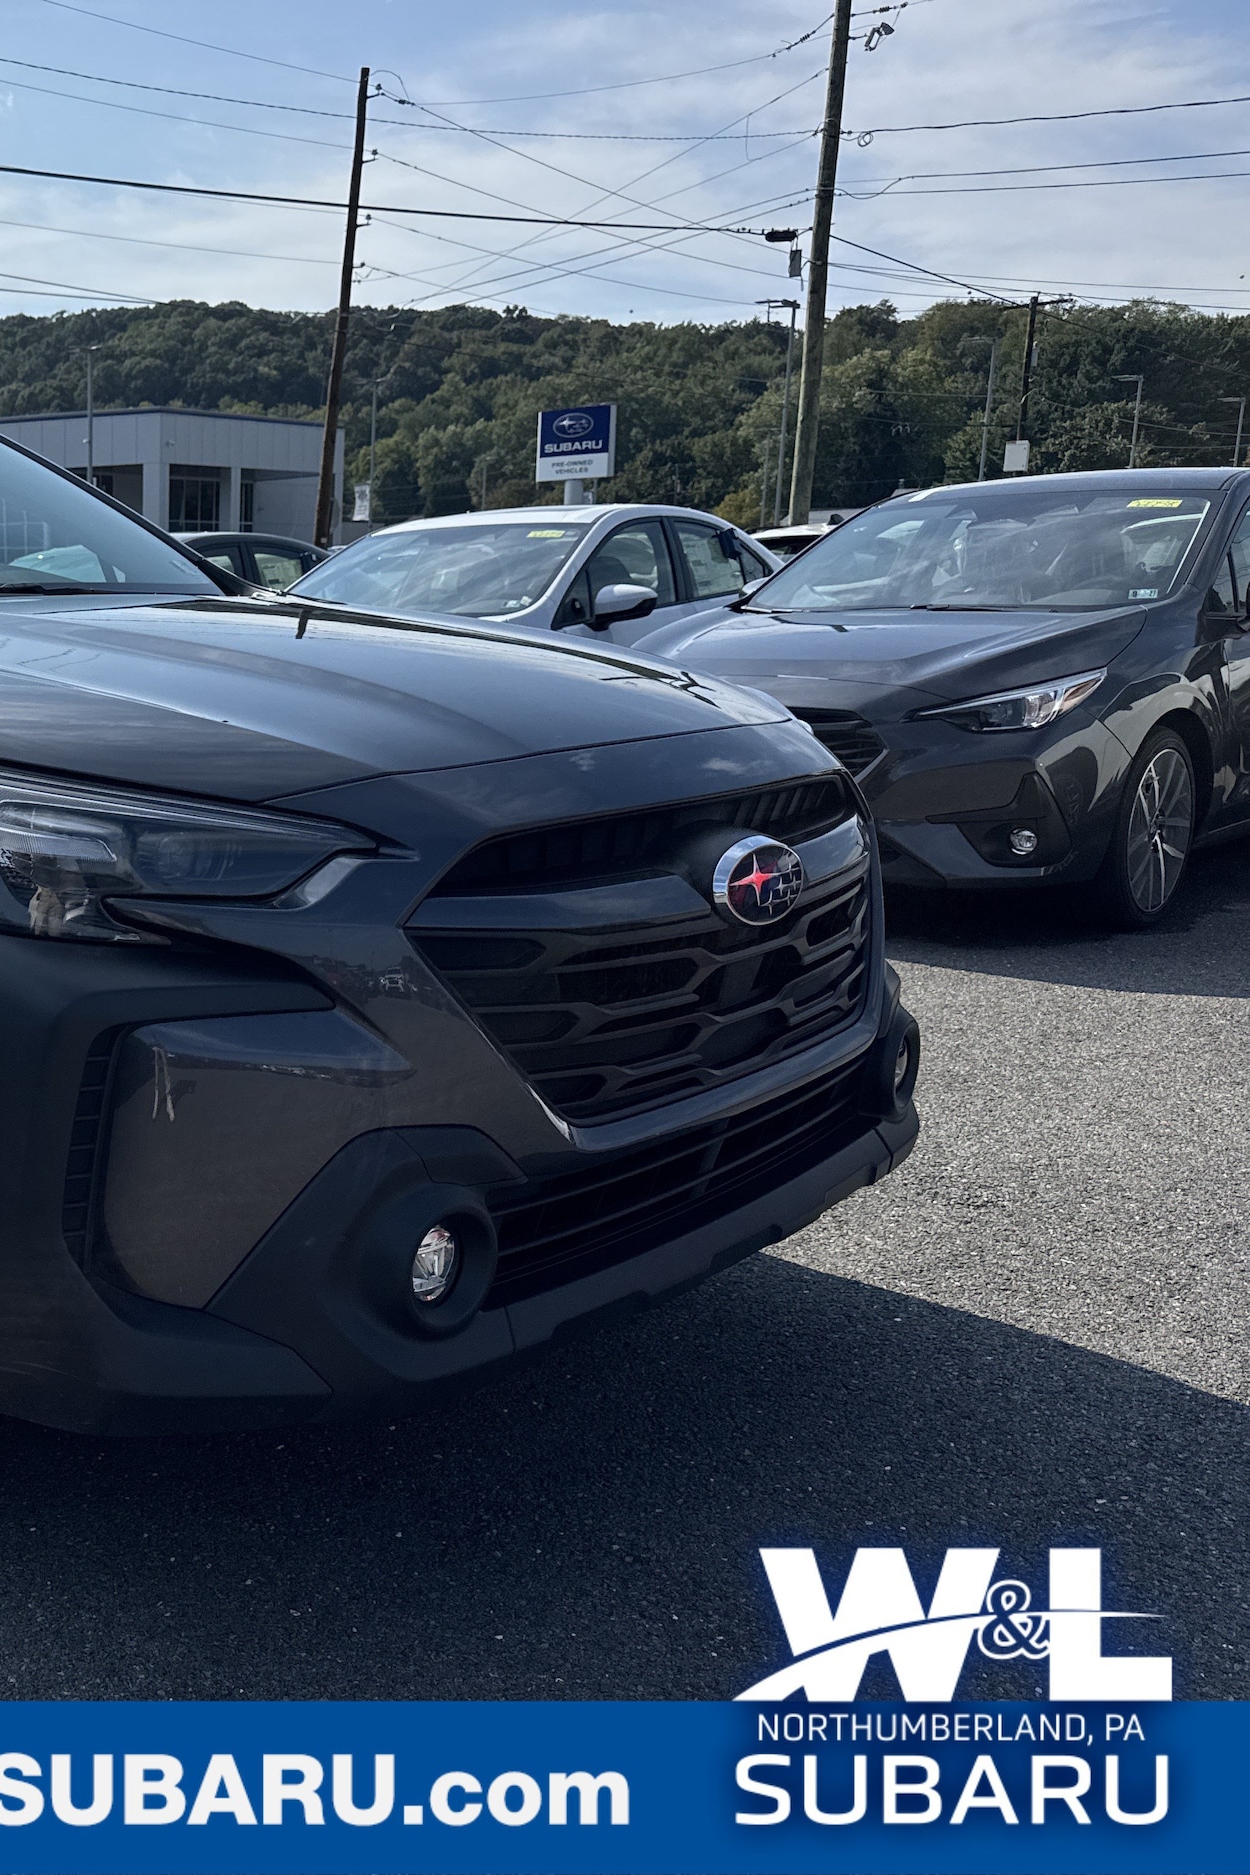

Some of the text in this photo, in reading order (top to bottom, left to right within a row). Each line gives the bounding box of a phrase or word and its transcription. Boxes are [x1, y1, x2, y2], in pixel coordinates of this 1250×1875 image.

[544, 440, 603, 454] SUBARU
[551, 460, 593, 468] PRE-OWNED
[554, 467, 589, 475] VEHICLES
